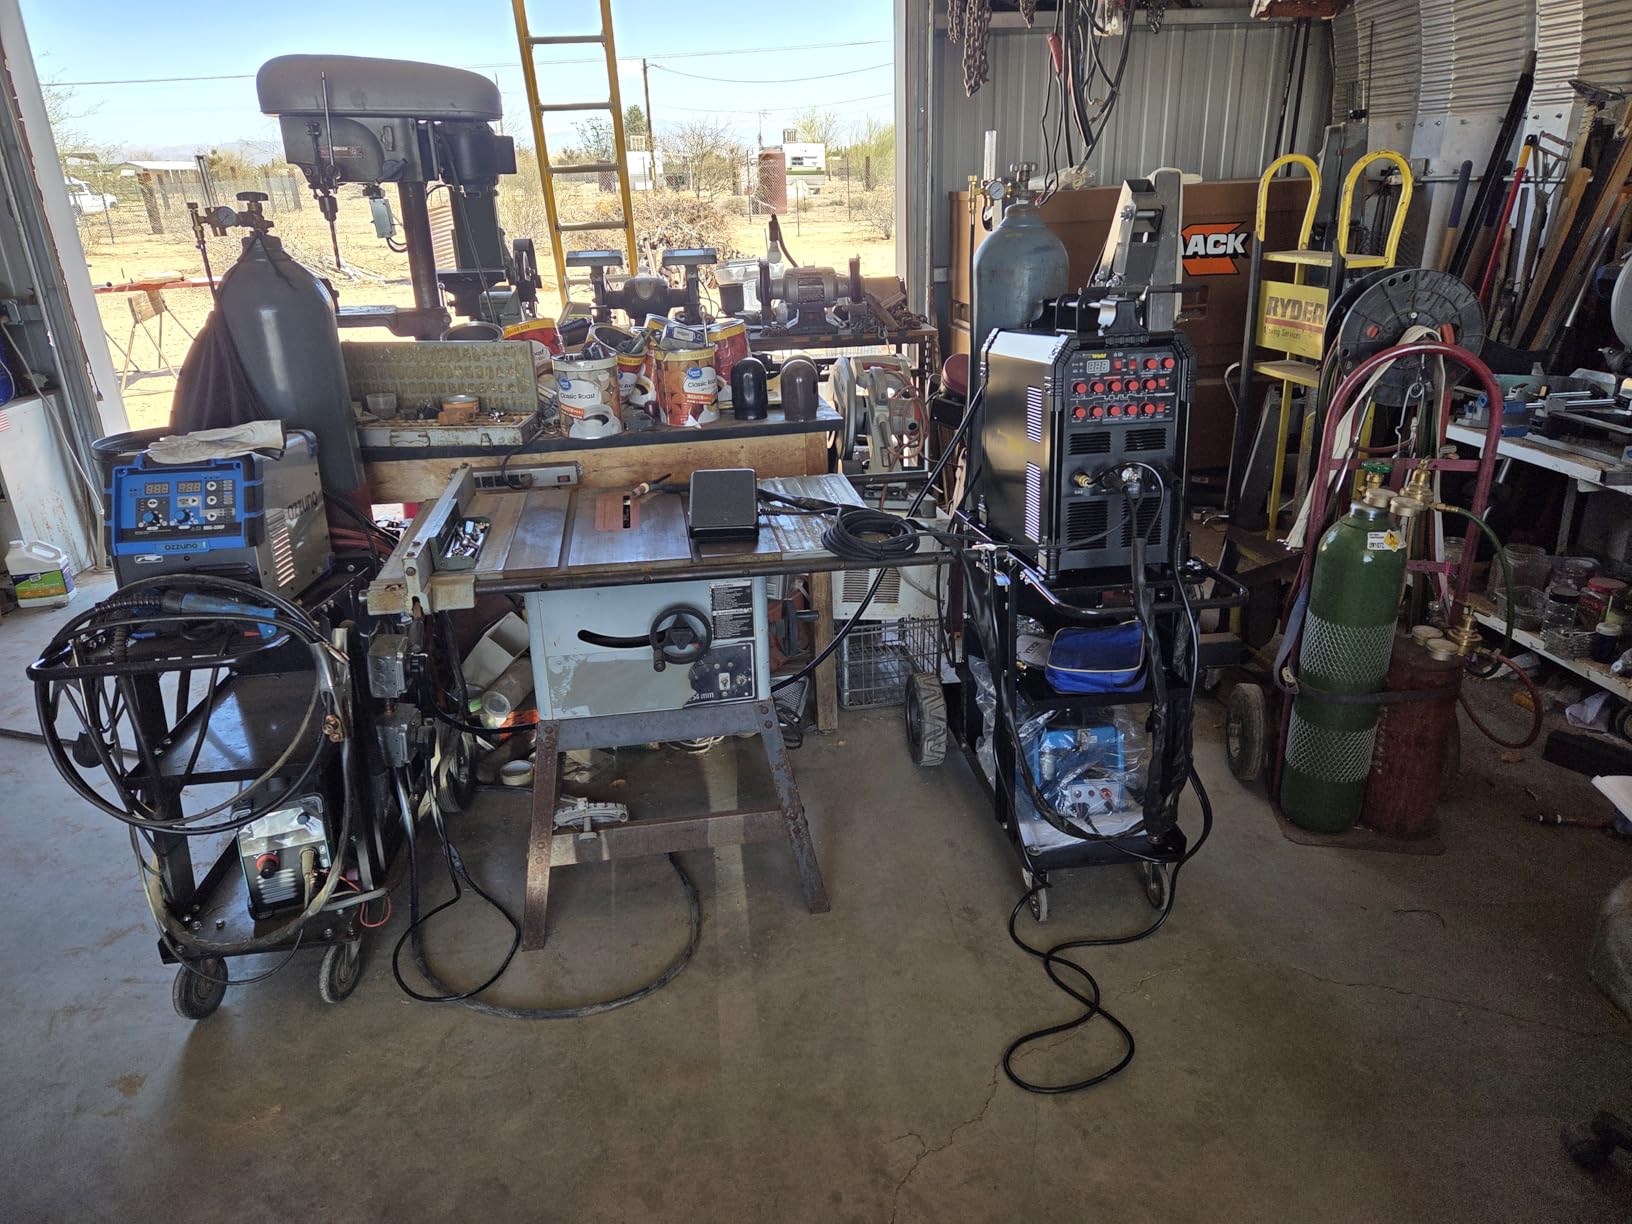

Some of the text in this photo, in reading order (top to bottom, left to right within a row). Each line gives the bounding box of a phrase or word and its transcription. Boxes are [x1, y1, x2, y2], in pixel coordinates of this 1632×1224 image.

[1266, 296, 1325, 326] RYDER
[560, 391, 596, 400] Classic Roast
[700, 692, 714, 700] mm
